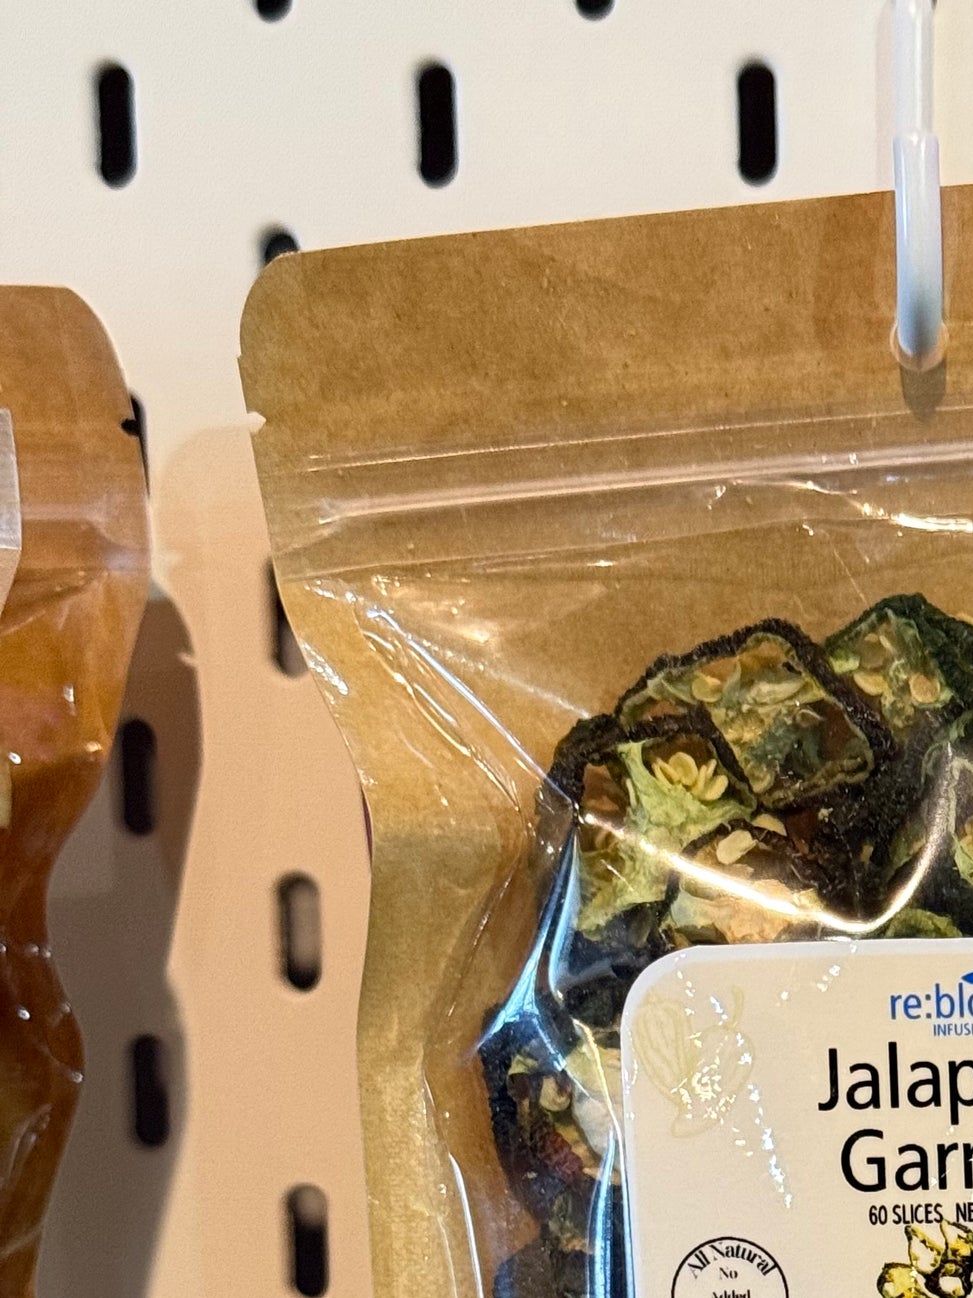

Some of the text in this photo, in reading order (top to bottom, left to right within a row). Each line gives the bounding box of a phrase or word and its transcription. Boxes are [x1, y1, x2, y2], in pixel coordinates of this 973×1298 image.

[868, 1204, 888, 1226] 60
[892, 1203, 943, 1225] SLICES
[687, 1242, 778, 1279] All Natural
[719, 1266, 739, 1280] No
